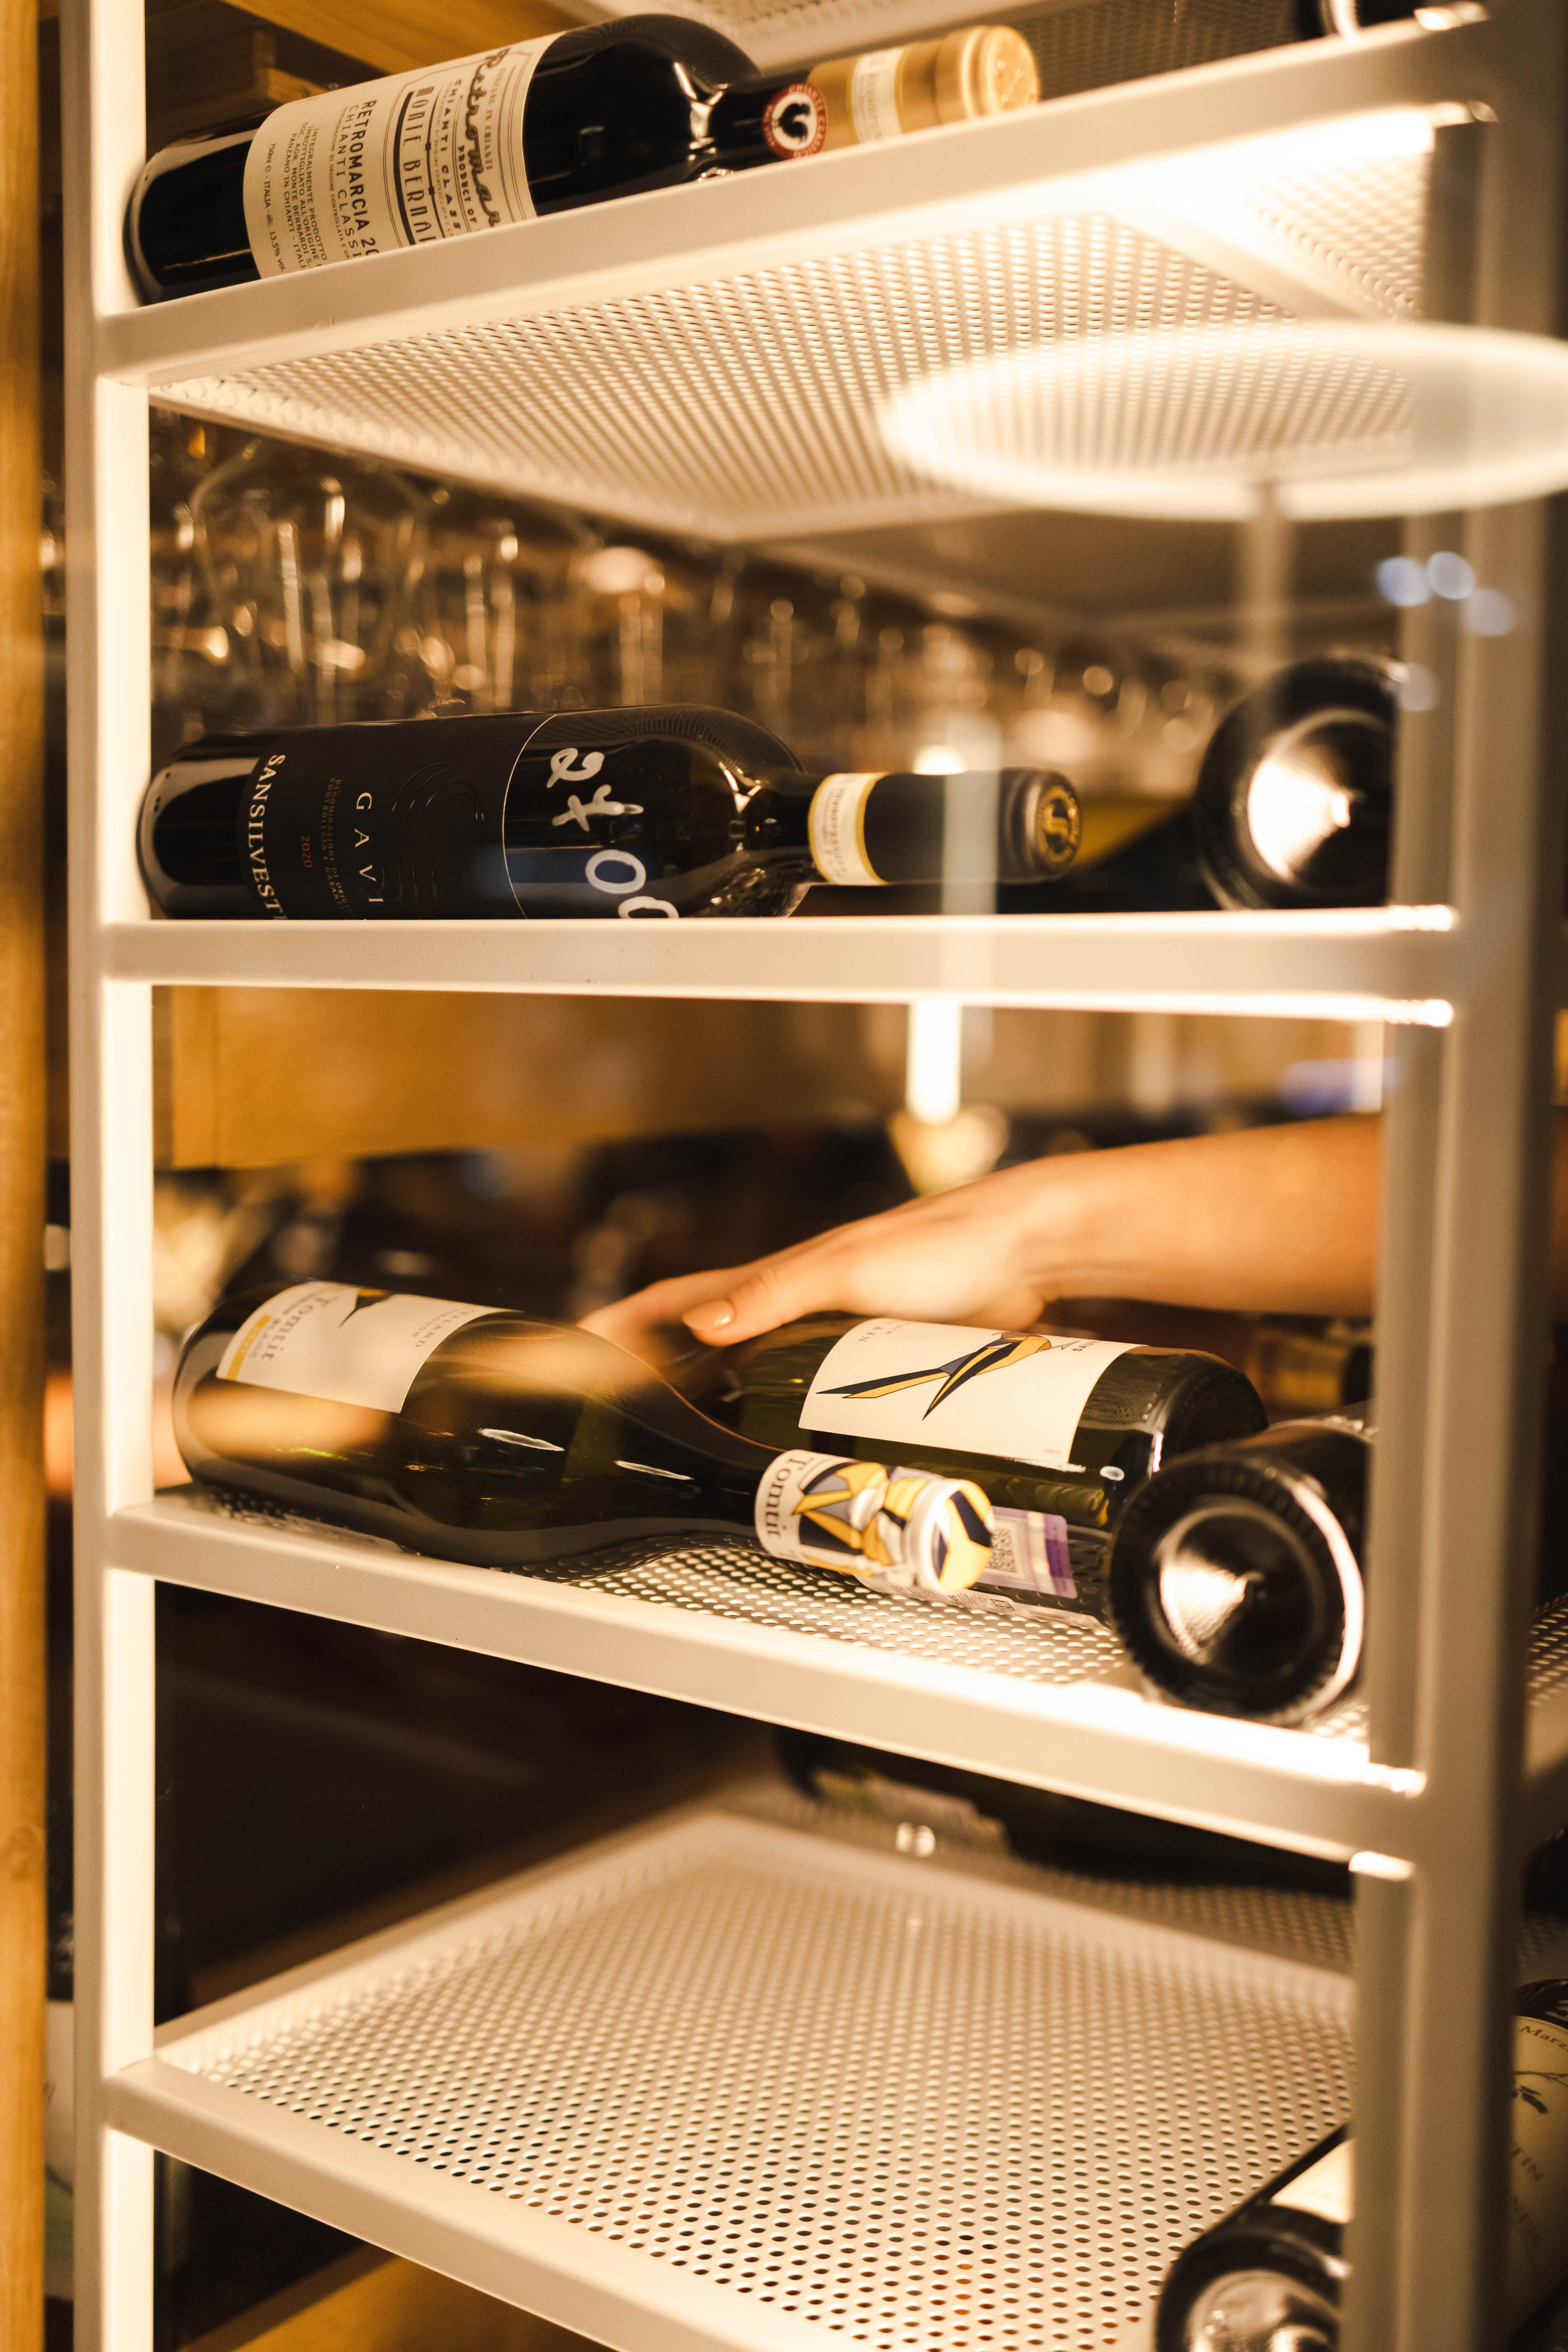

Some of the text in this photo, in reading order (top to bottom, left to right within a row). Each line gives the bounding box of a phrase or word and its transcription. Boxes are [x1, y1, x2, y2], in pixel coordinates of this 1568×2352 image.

[336, 105, 360, 177] CHIANTI
[403, 85, 435, 146] MONTE
[440, 79, 462, 151] CHIANTI
[268, 142, 277, 163] 750ml
[291, 143, 301, 164] AGR.
[298, 125, 314, 196] IMBOTTIGLIATO
[306, 127, 320, 205] INTEGRALMENTE
[348, 100, 377, 231] RETROMARCIA
[457, 145, 478, 224] PRODUCT OF
[284, 132, 306, 270] PANZANO IN CHIANTI ITALI
[293, 205, 309, 254] BERNARDI
[300, 200, 320, 260] ALL'ORIGINE
[330, 194, 344, 241] CONTROLLATA
[269, 231, 281, 257] 13.5%
[277, 258, 286, 272] vol.
[309, 208, 327, 261] PRODOTTO
[320, 777, 336, 851] CONTROLLATA
[327, 778, 342, 863] DENOMINAZIONE
[300, 834, 314, 869] 2020
[331, 867, 339, 878] DI
[355, 792, 385, 903] GAVI
[765, 1457, 814, 1539] Tomtit
